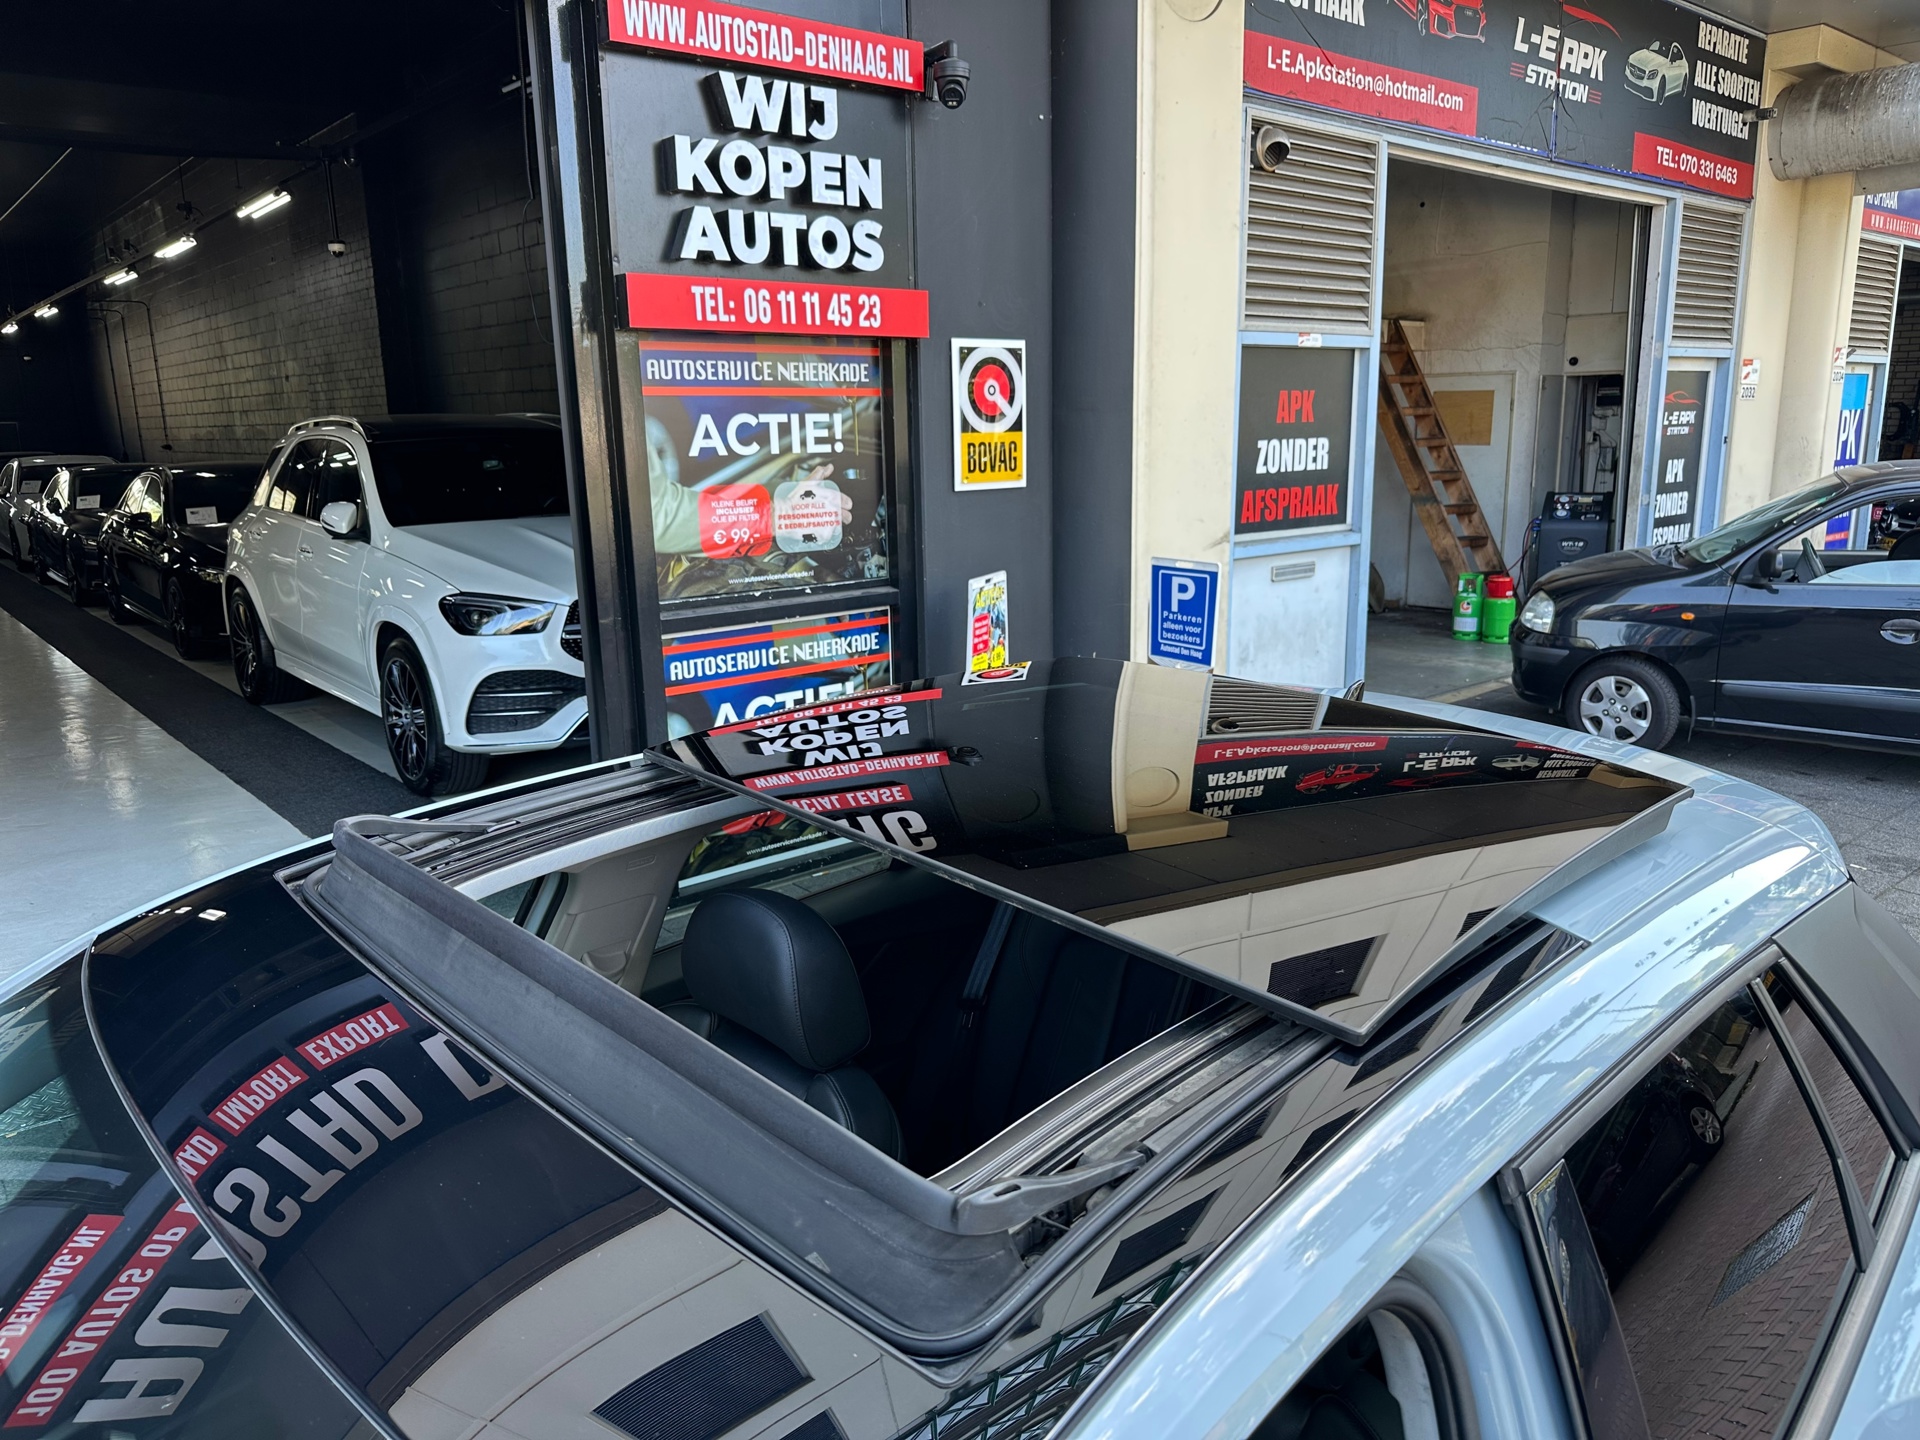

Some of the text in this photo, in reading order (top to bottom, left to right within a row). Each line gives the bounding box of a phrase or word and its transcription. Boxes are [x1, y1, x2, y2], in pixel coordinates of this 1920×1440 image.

[622, 0, 914, 84] WWW.AUTOSTAD-DENHAAG.NL
[1513, 16, 1607, 82] L-E APK
[1697, 20, 1750, 65] REPARATIE
[1267, 45, 1464, 112] L-E.Apkstation@hotmail.com
[1525, 63, 1589, 104] STATION
[1693, 59, 1760, 106] ALLE SOORTEN
[718, 70, 839, 141] WIJ
[1691, 97, 1750, 141] VOERTUIGEN
[673, 134, 883, 210] KOPEN
[1656, 145, 1678, 169] TEL:
[1679, 152, 1698, 175] 070
[1699, 158, 1715, 179] 331
[1715, 163, 1738, 185] 6463
[680, 205, 884, 272] AUTOS
[691, 285, 882, 328] TEL: 06 11 11 45 23
[646, 359, 870, 383] AUTOSERVICE NEHERKADE
[1276, 389, 1316, 424] APK
[1741, 386, 1756, 399] 2032
[688, 412, 845, 457] ACTIE!
[1666, 426, 1690, 436] STATION
[1679, 410, 1697, 425] APK
[967, 441, 1018, 474] BOVAG
[1255, 437, 1330, 475] ZONDER
[1664, 458, 1685, 484] APK
[711, 498, 758, 508] KLEINE BEURT
[711, 515, 728, 523] OLIE
[740, 514, 760, 522] FILTER
[716, 507, 754, 515] INCLUSIEF
[777, 511, 839, 520] PERSONENAUTO'S
[792, 503, 811, 511] VOOR
[1240, 484, 1340, 524] AFSPRAAK
[1654, 491, 1689, 519] ZONDER
[713, 527, 760, 544] € 99,-
[728, 570, 815, 585] www.autoserviceneherkade.nl
[1171, 575, 1196, 613] P
[1163, 611, 1202, 624] Parkeren
[1163, 622, 1202, 634] alleen voor
[1160, 643, 1203, 660] Autostad Den Haag
[1162, 631, 1201, 644] bezoekers
[669, 632, 880, 681] AUTOSERVICE NEHERKADE
